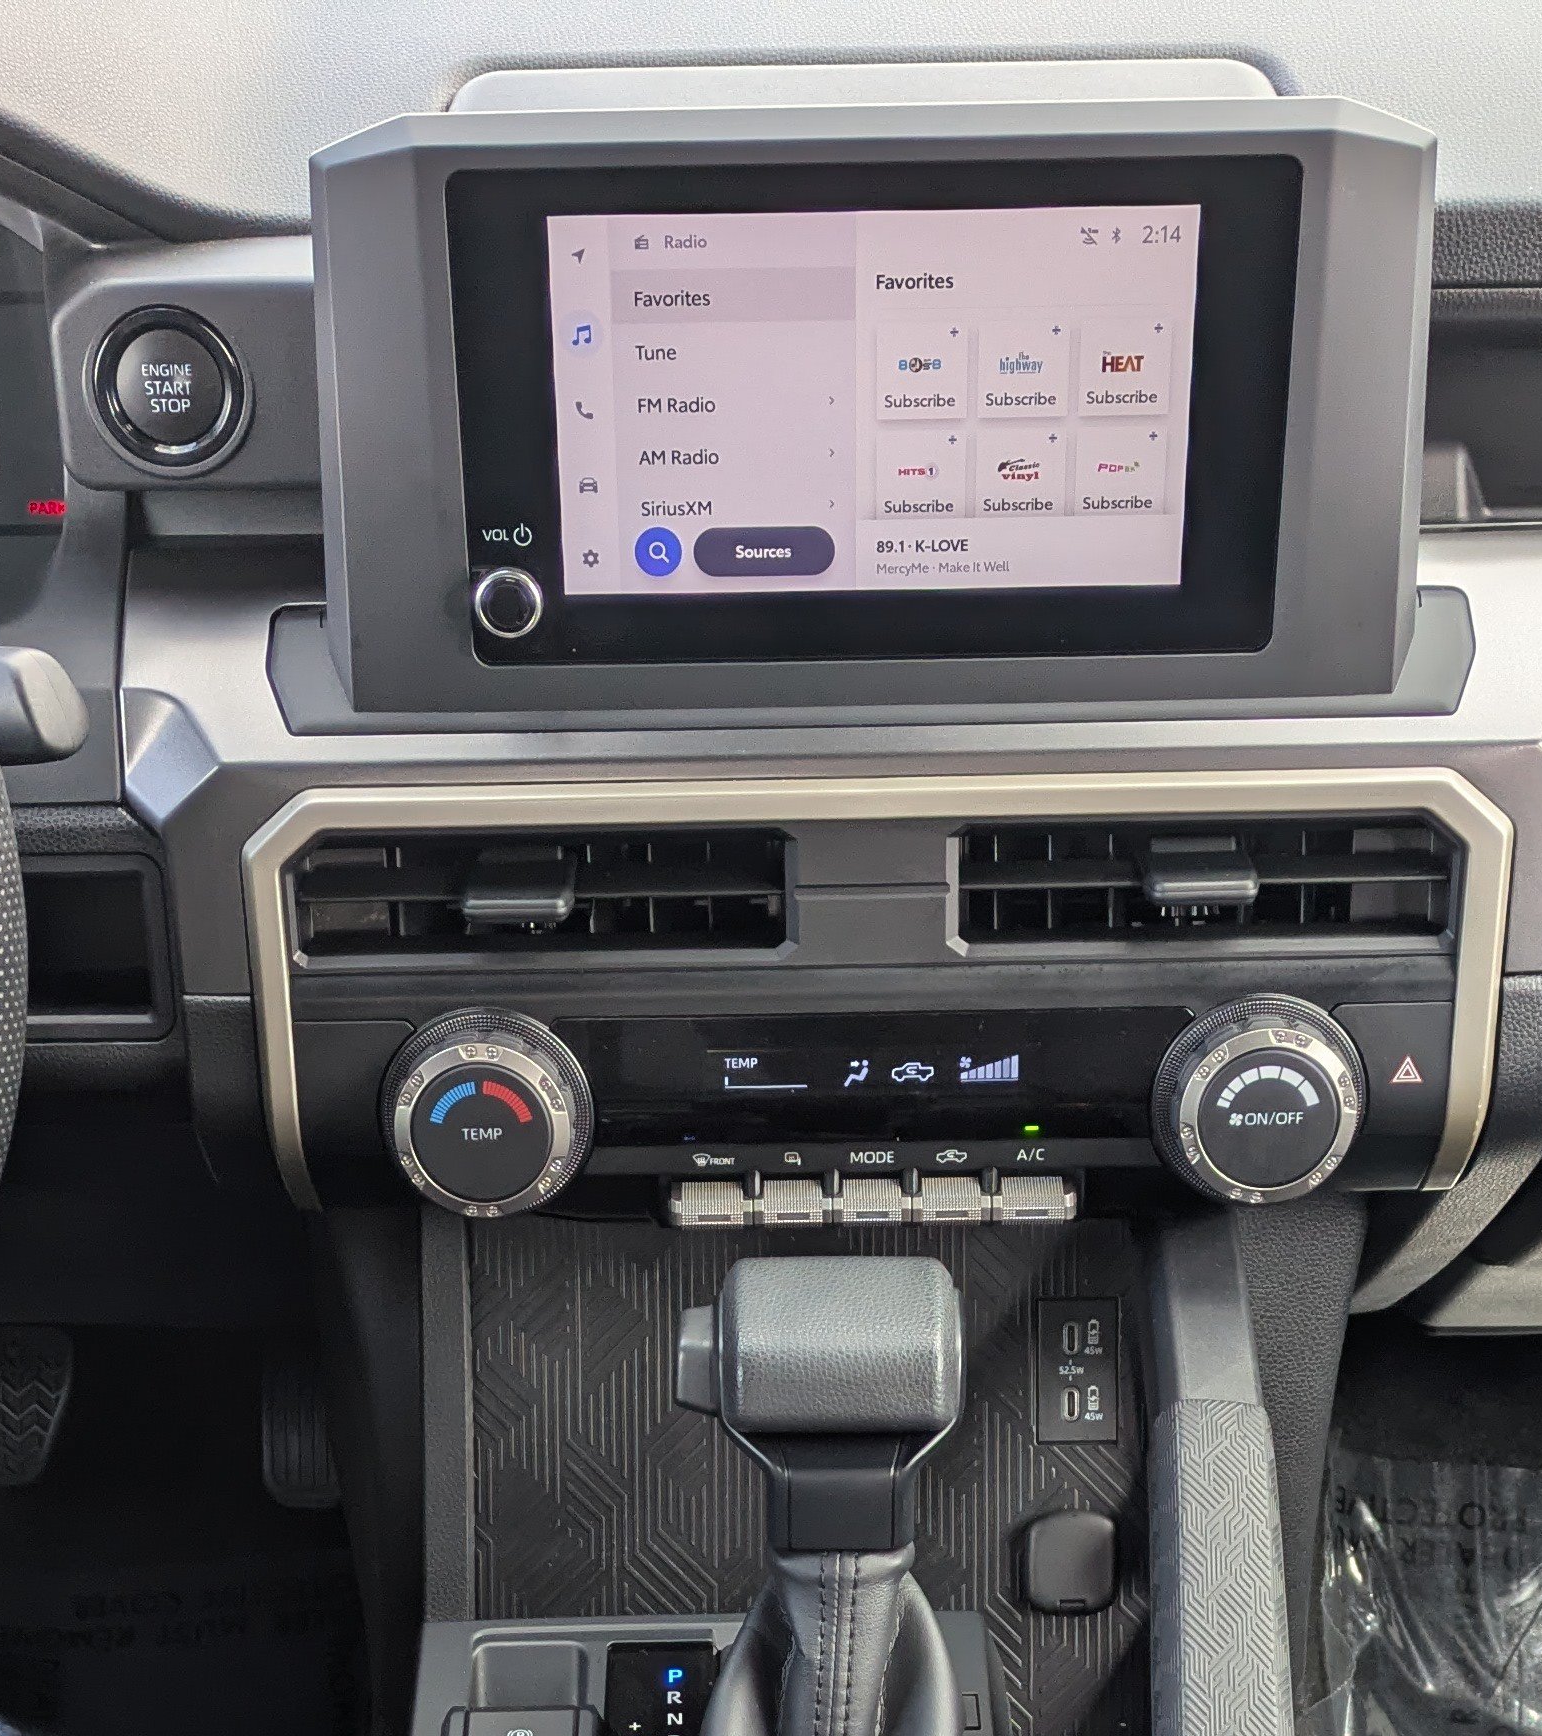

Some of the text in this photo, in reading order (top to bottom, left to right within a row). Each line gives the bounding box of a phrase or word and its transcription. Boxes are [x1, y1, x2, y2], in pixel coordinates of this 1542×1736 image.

[664, 235, 708, 249] Radio
[1142, 225, 1182, 244] 2:14
[875, 273, 954, 290] Favorites
[634, 290, 711, 307] Favorites
[635, 345, 677, 361] Tune
[141, 363, 192, 377] ENGINE
[999, 355, 1044, 375] highway
[1101, 355, 1145, 373] HEAT
[144, 381, 192, 395] START
[638, 397, 716, 413] FM Radio
[884, 393, 957, 408] Subscribe
[985, 392, 1057, 407] Subscribe
[1086, 390, 1158, 405] Subscribe
[150, 398, 191, 413] STOP
[639, 449, 719, 465] AM Radio
[898, 467, 926, 477] HITS
[1001, 471, 1041, 482] vinyl
[641, 500, 712, 517] SiriusXM
[884, 499, 955, 514] Subscribe
[983, 498, 1054, 513] Subscribe
[1082, 495, 1154, 511] Subscribe
[482, 528, 510, 542] VOL
[735, 544, 792, 559] Sources
[876, 539, 969, 554] 89.1 K-LOVE
[876, 560, 1010, 577] MercyMe Make It Well
[725, 1057, 758, 1069] TEMP
[1244, 1111, 1304, 1126] ON/OFF
[461, 1127, 503, 1140] TEMP
[709, 1156, 736, 1166] FRONT
[850, 1151, 895, 1164] MODE
[1016, 1148, 1045, 1162] A/C
[1083, 1346, 1103, 1355] 45W
[1084, 1412, 1104, 1422] 45W
[668, 1669, 683, 1683] P
[667, 1692, 683, 1704] R
[667, 1713, 683, 1726] N
